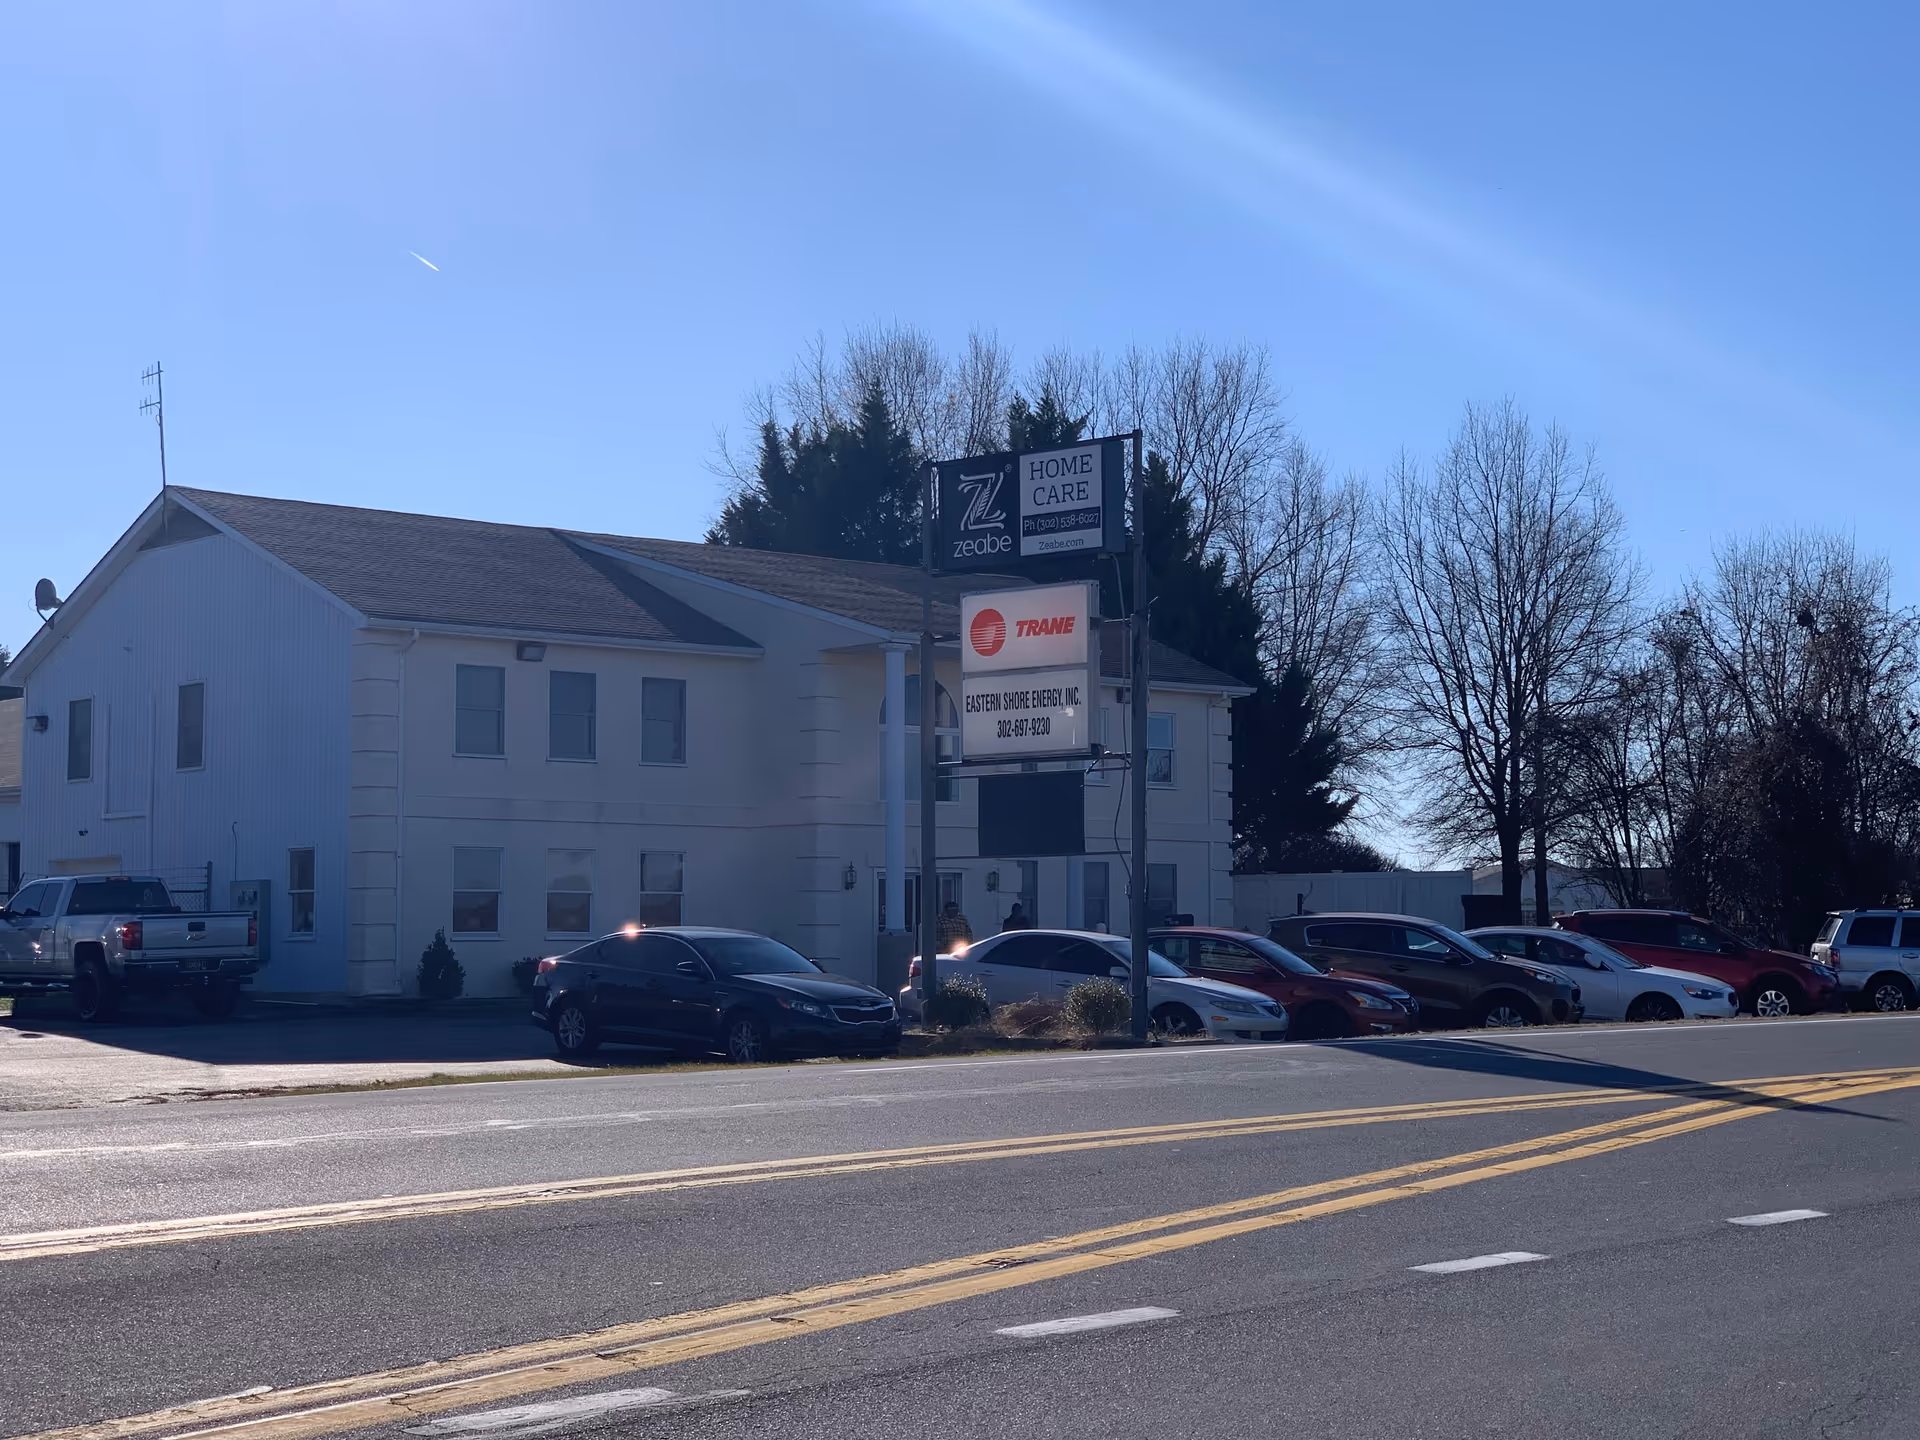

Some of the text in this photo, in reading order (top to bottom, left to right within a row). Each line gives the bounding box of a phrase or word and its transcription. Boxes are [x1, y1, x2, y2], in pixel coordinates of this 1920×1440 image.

[1029, 453, 1093, 481] HOME
[1032, 480, 1089, 506] CARE
[1036, 516, 1060, 532] (302)
[1060, 512, 1099, 529] 538-6027
[953, 533, 1012, 558] zeabe
[1038, 537, 1084, 551] Zeabe.com
[1016, 616, 1075, 637] TRANE
[966, 686, 1082, 713] EASTERN SHORE ENERGY, INC.
[997, 717, 1051, 738] 302-697-9230
